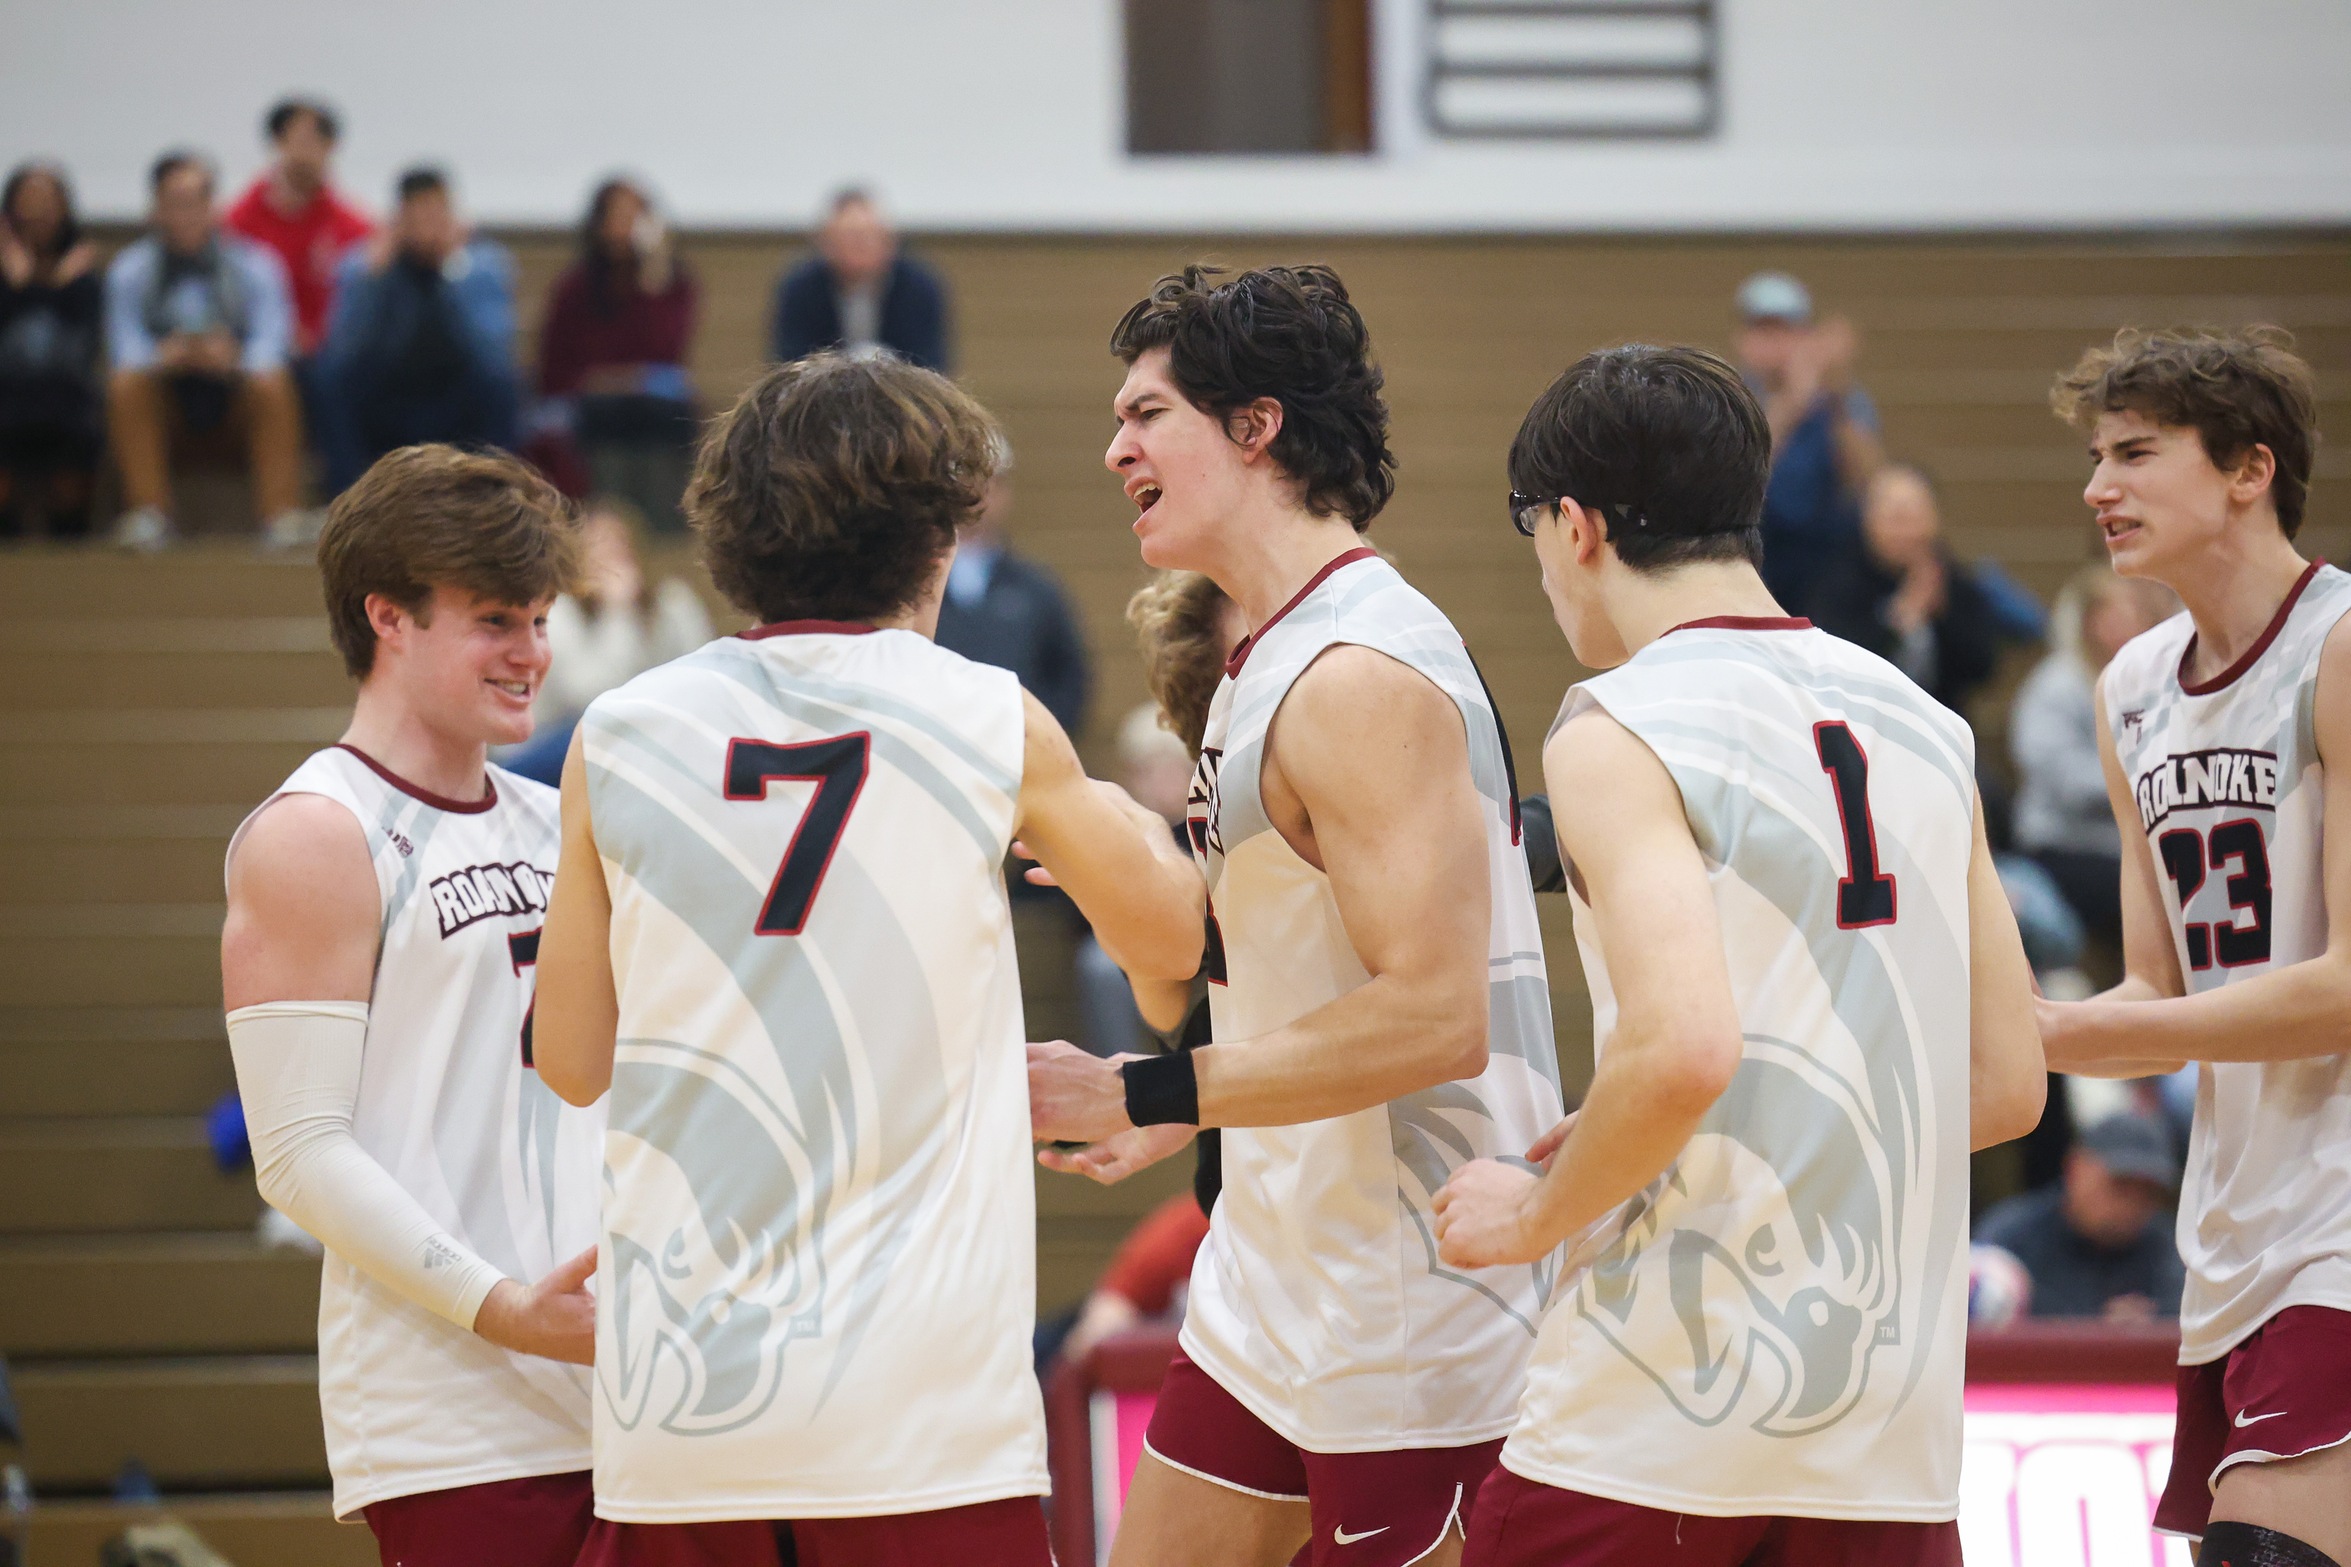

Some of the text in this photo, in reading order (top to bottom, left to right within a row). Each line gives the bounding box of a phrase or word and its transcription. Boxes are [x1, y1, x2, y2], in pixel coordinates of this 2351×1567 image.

[723, 730, 871, 936] 7
[1812, 720, 1897, 930] 1
[2158, 817, 2273, 972] 23
[1879, 1326, 1895, 1338] TM
